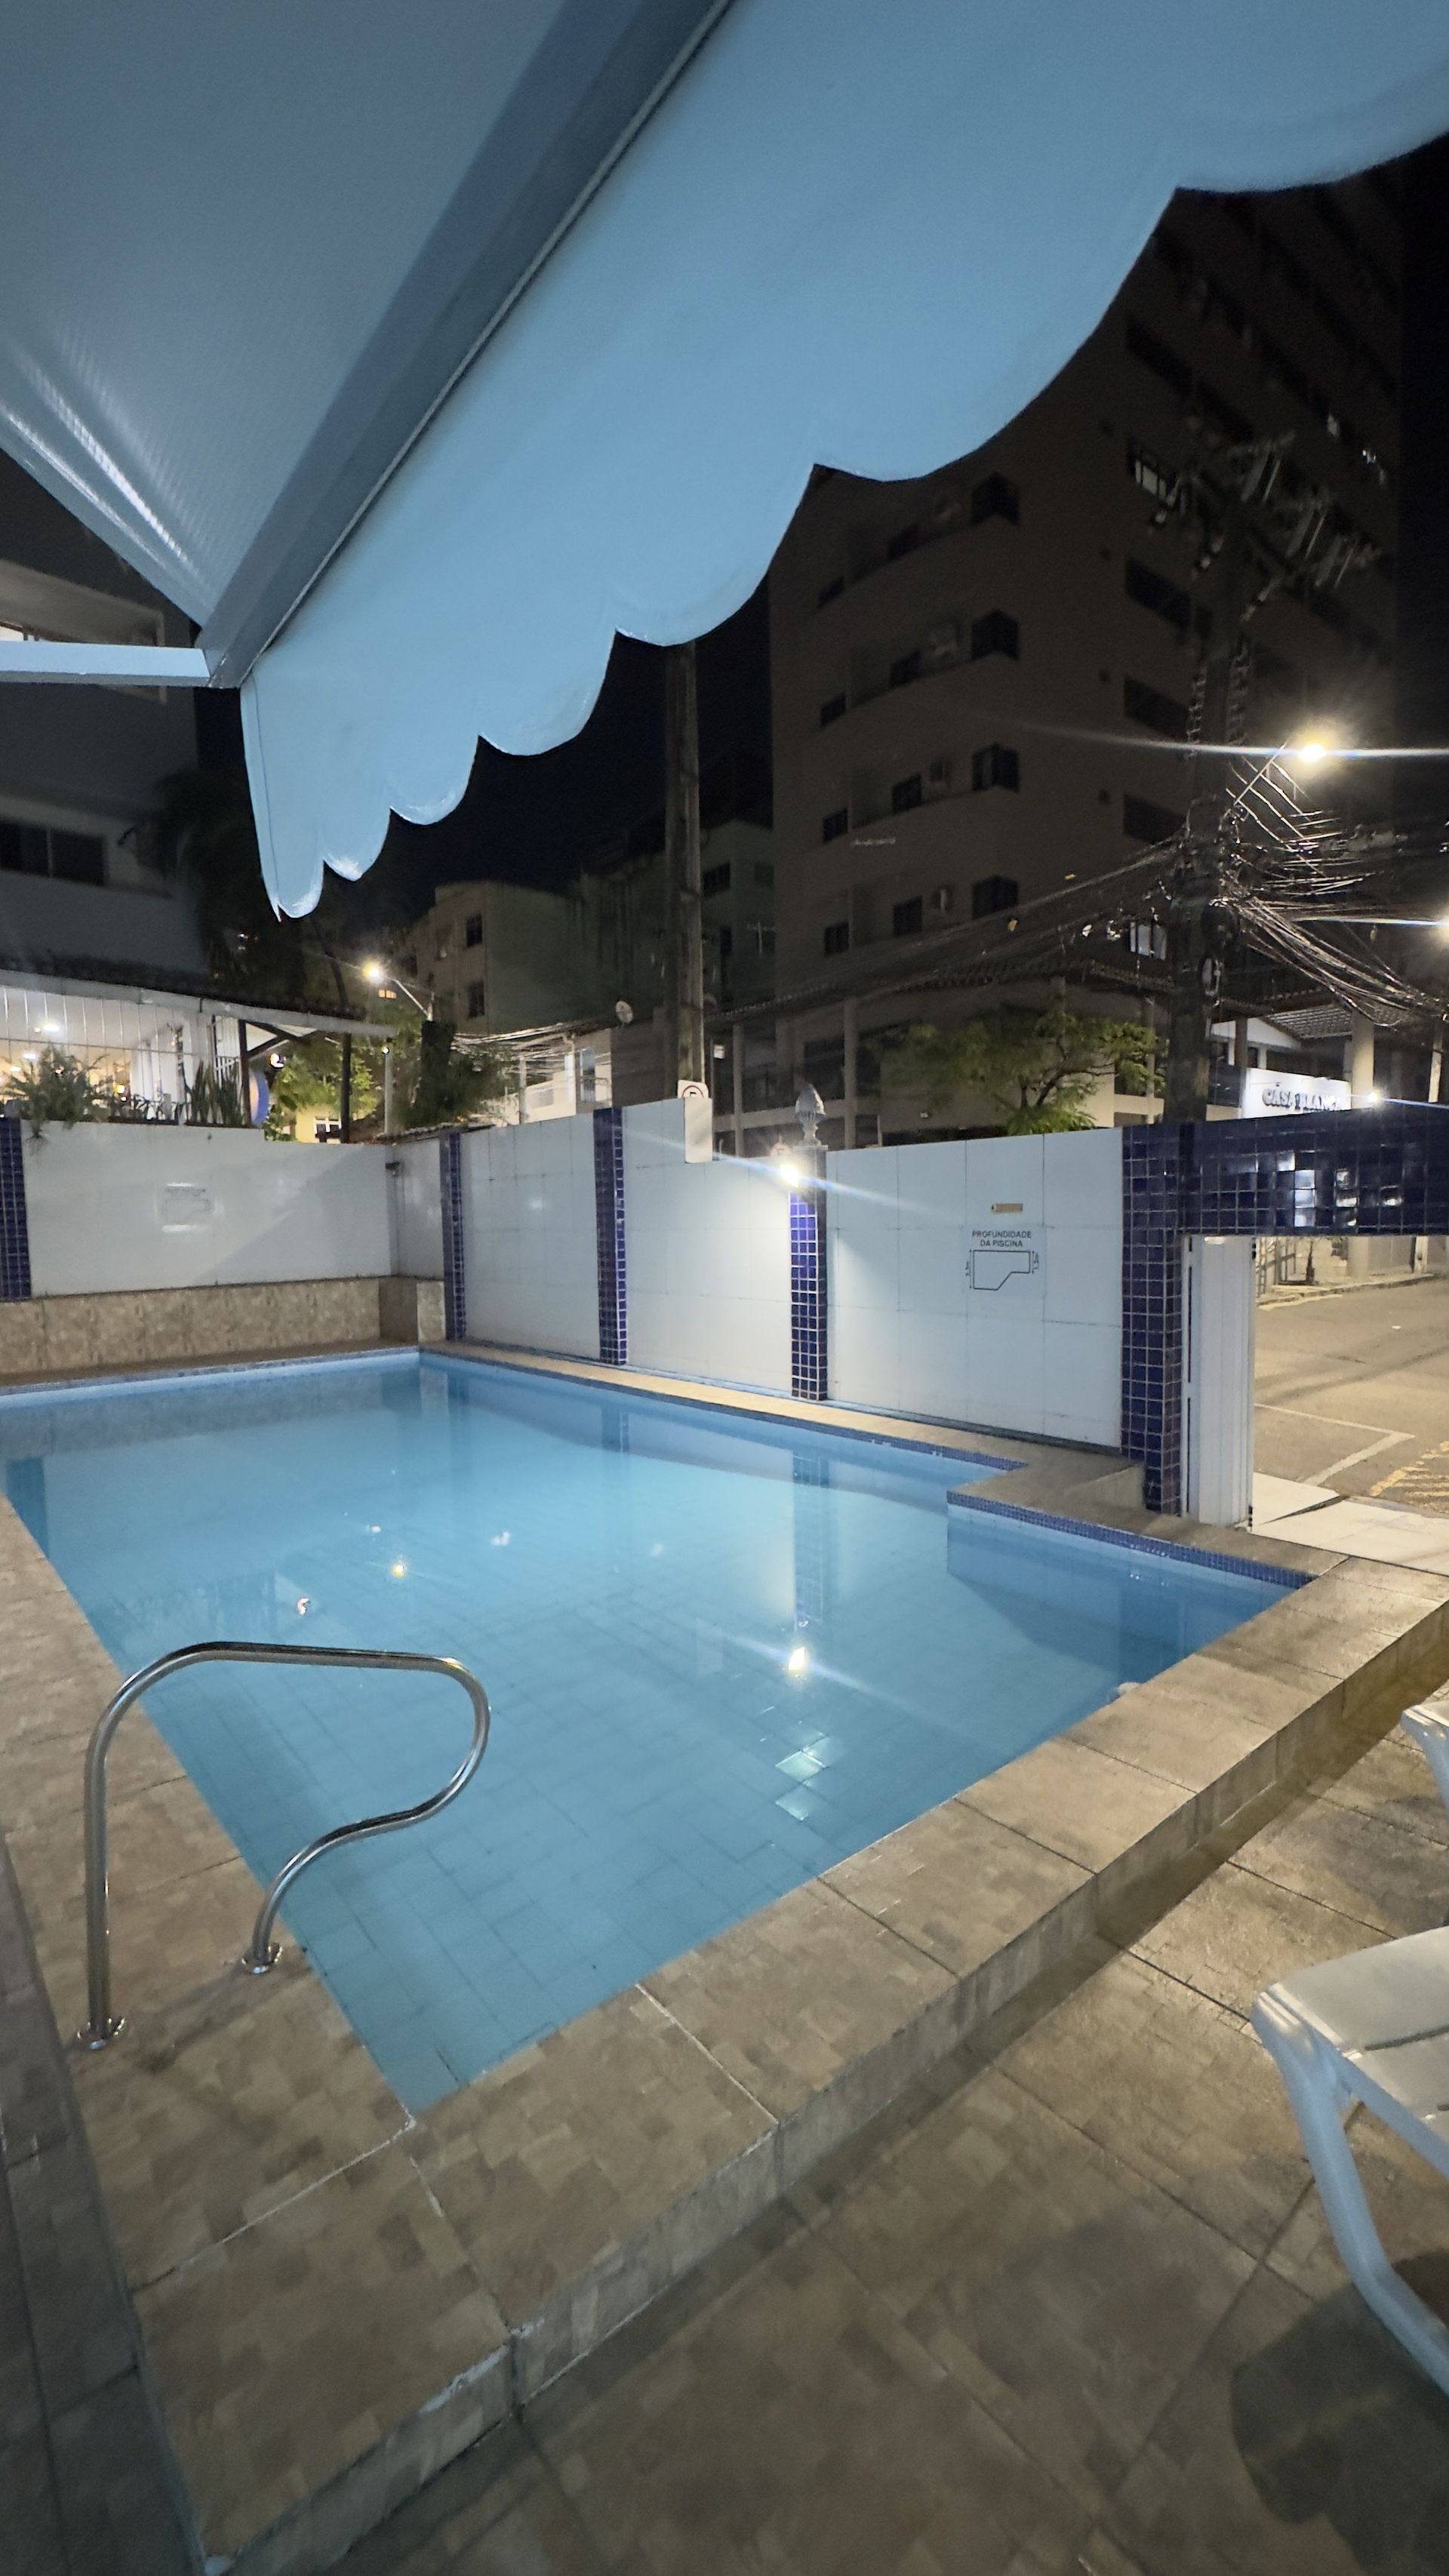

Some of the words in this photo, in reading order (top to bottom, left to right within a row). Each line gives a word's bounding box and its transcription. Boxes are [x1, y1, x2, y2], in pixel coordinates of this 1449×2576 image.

[1263, 1088, 1292, 1108] CASA
[972, 1230, 1032, 1239] PROFUNDIDADE
[992, 1239, 1023, 1248] PISCINA
